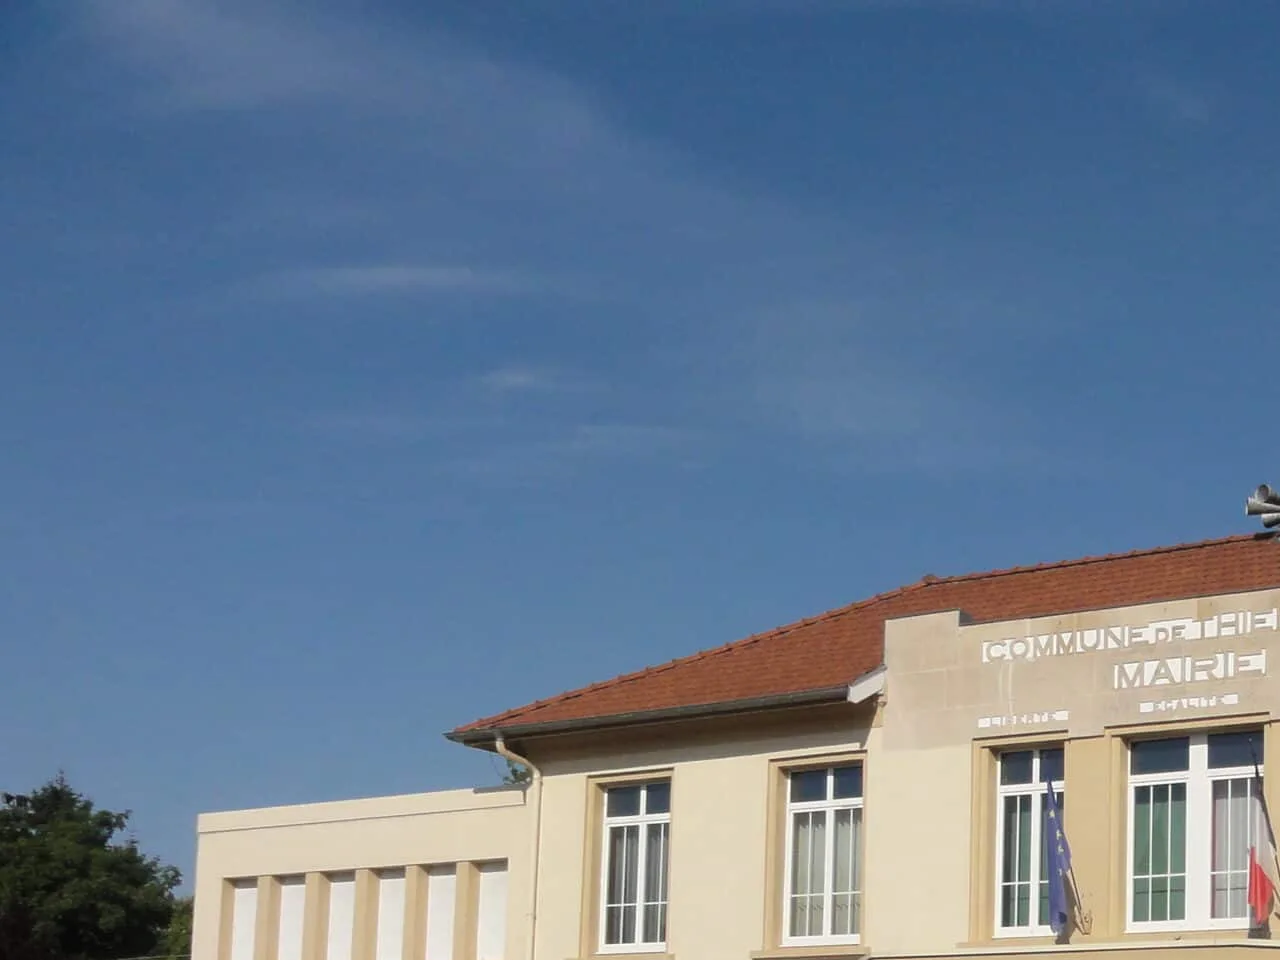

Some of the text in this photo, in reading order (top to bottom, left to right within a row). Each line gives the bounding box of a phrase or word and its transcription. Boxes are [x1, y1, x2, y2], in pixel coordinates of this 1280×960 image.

[985, 626, 1149, 662] COMMUNE
[1154, 624, 1187, 642] DE
[1118, 651, 1264, 690] MAIRIE
